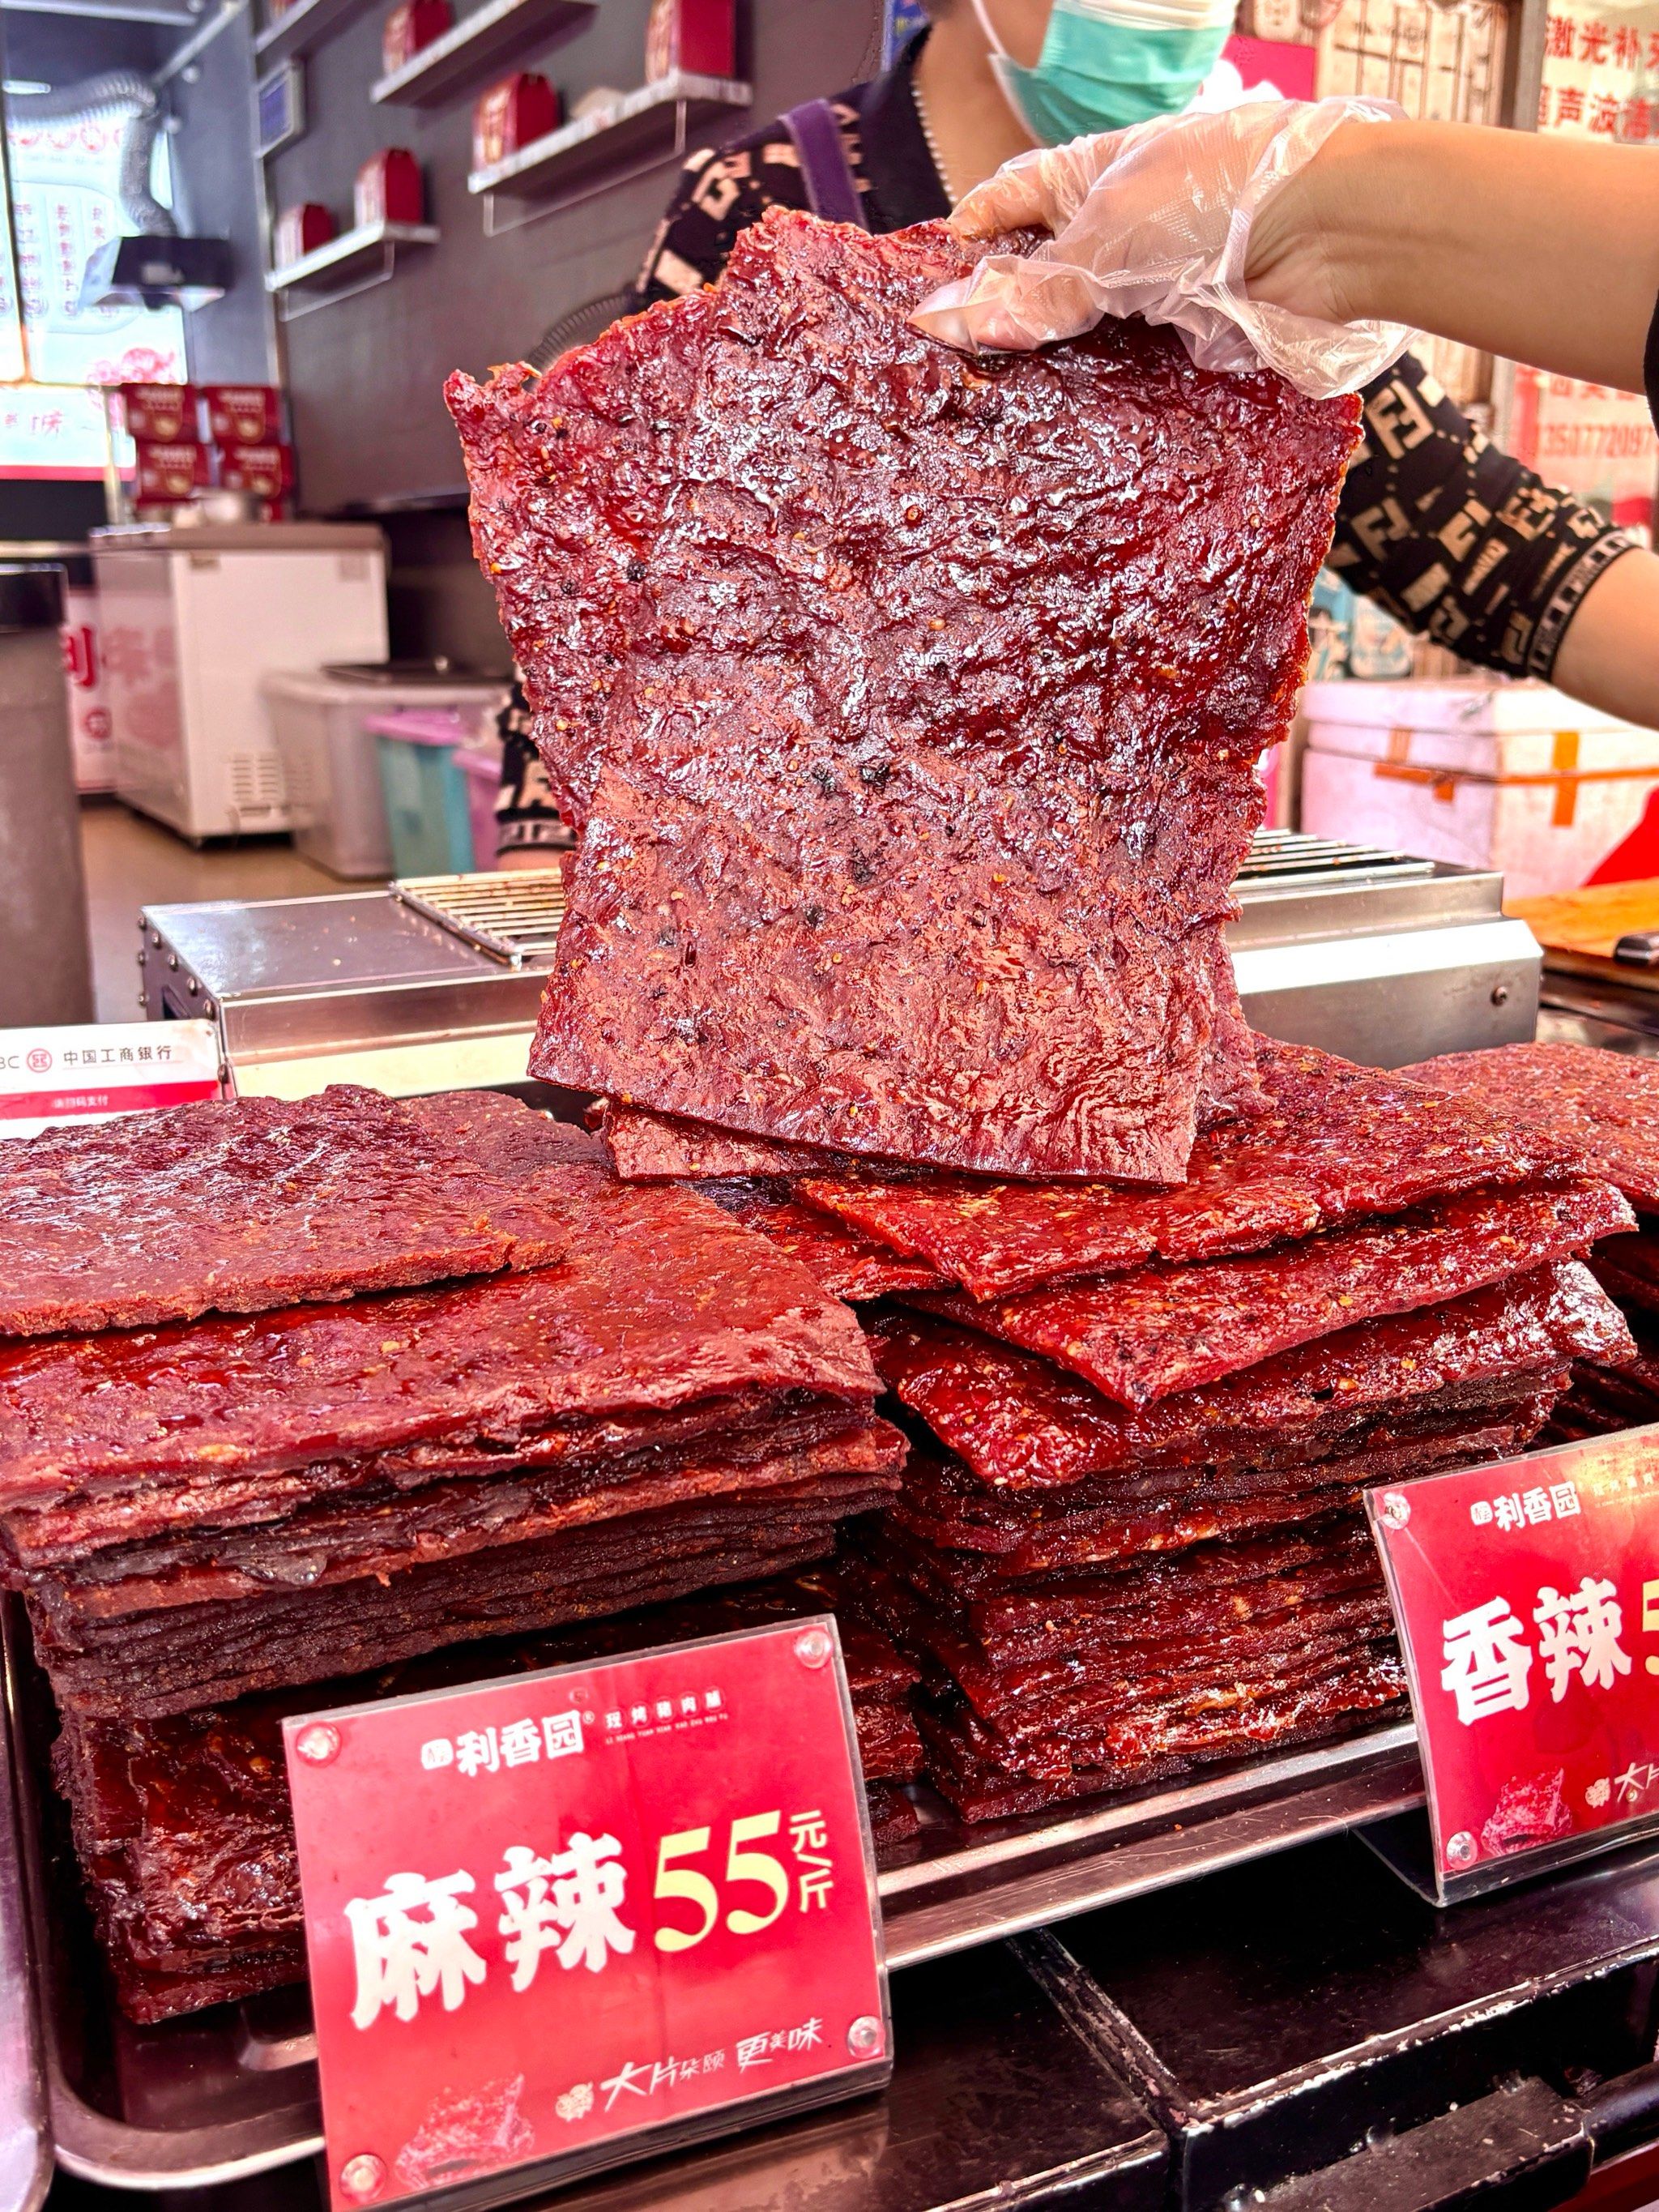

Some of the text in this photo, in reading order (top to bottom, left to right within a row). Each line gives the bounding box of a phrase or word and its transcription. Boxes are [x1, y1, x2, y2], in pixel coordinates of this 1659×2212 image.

[63, 1044, 173, 1066] 中国工商银行
[1493, 1480, 1581, 1532] 利香园
[1439, 1576, 1632, 1727] 香辣
[455, 1709, 584, 1778] 利香园
[344, 1832, 636, 2031] 麻辣
[653, 1809, 789, 1953] 55
[736, 2016, 824, 2074] 更美味
